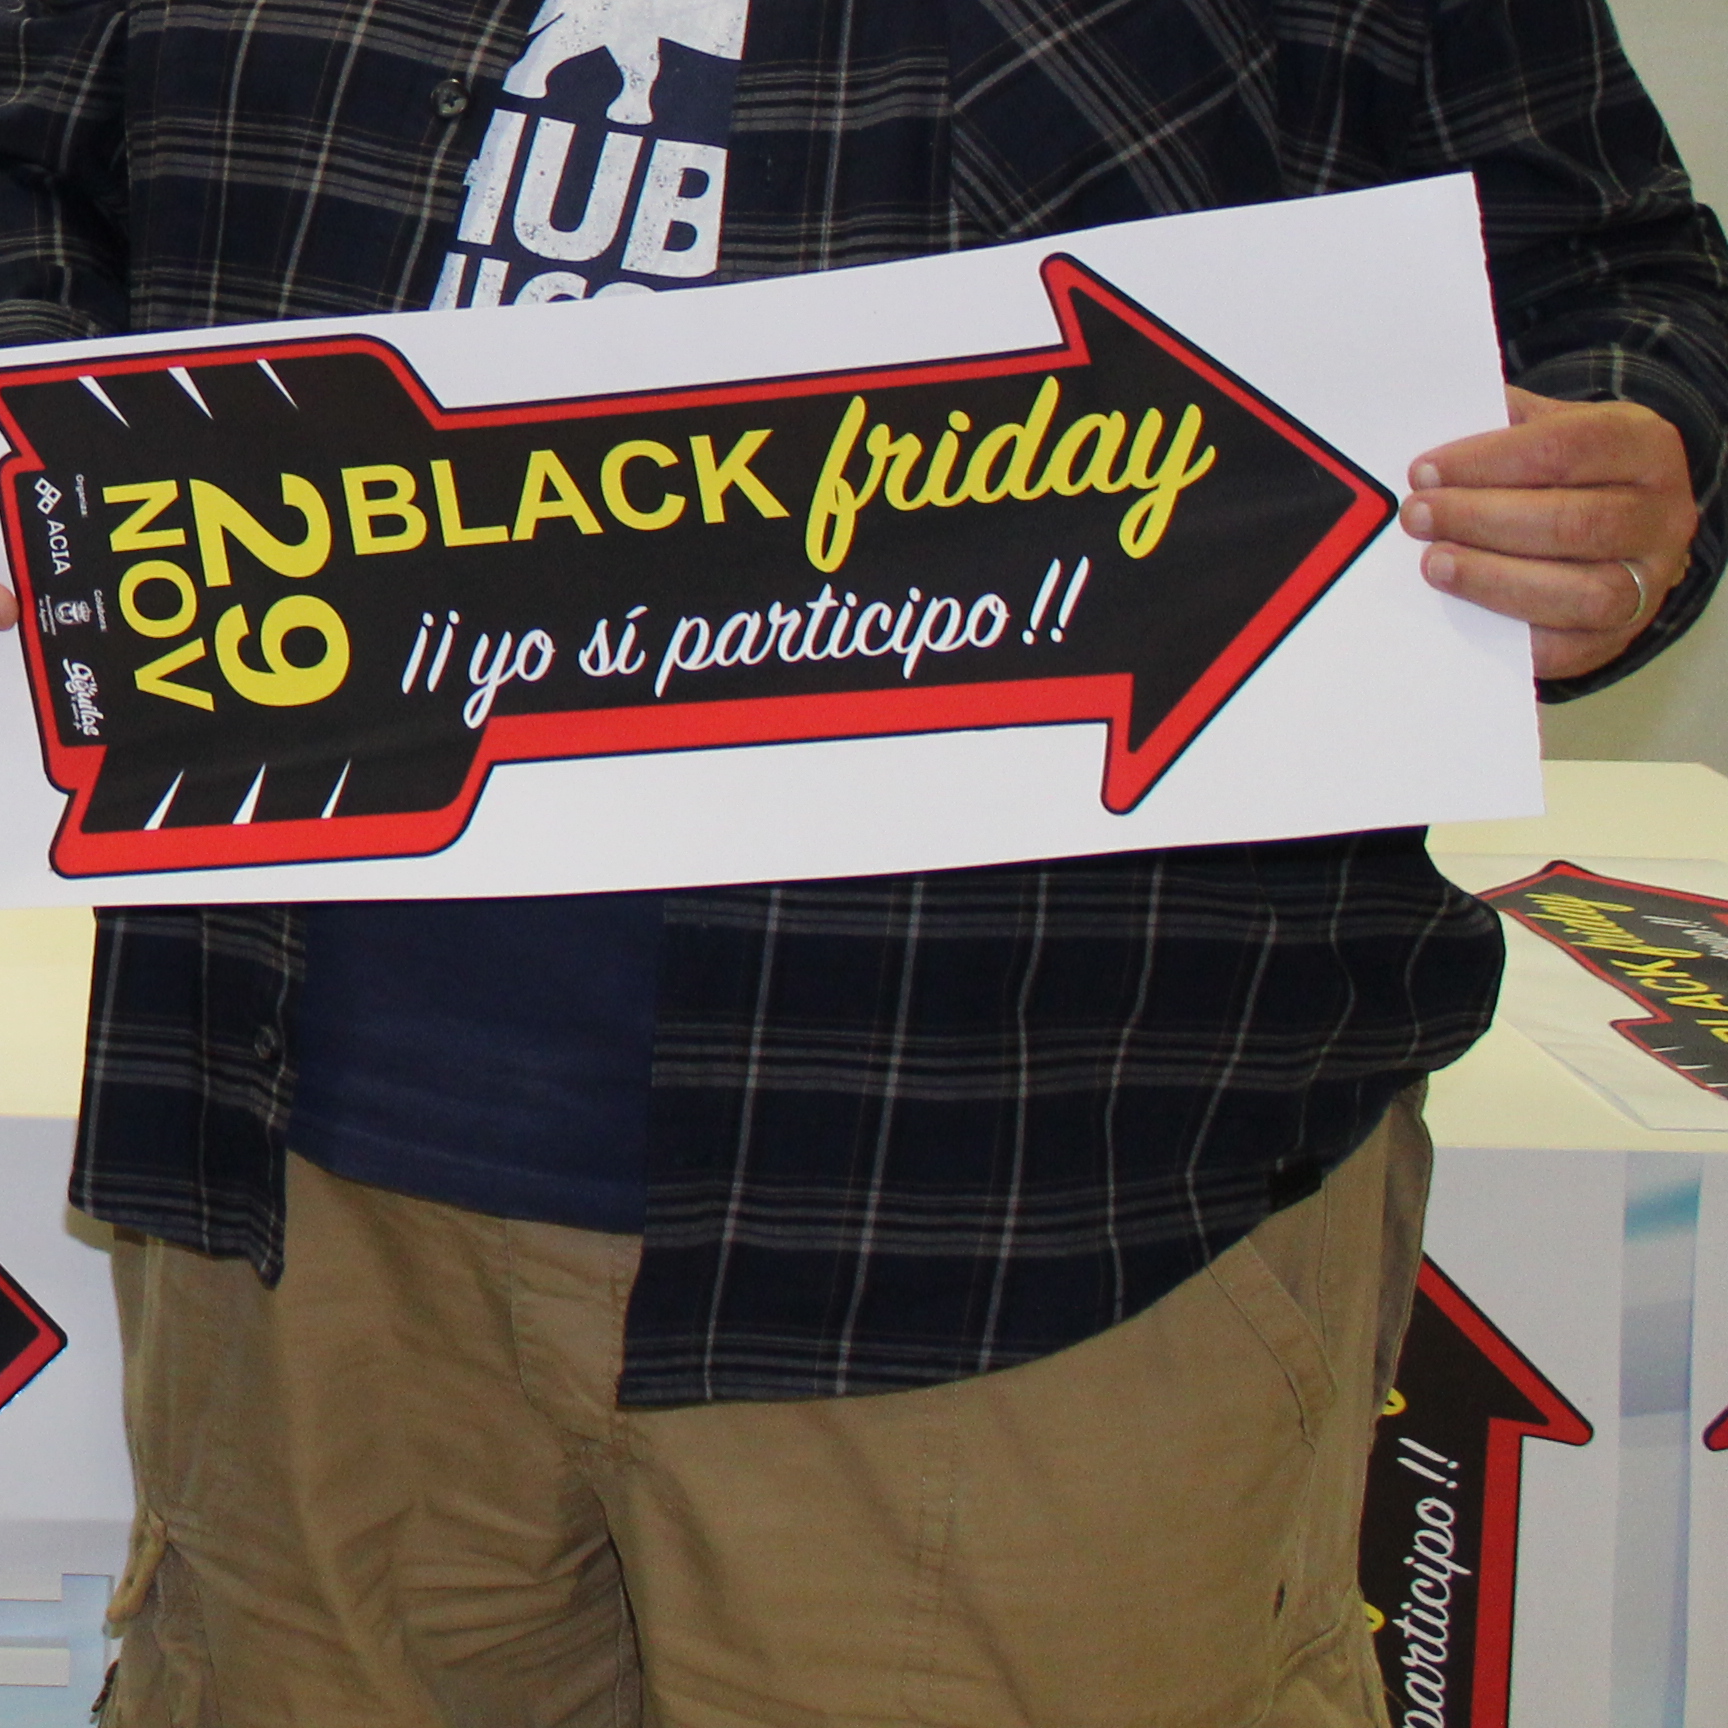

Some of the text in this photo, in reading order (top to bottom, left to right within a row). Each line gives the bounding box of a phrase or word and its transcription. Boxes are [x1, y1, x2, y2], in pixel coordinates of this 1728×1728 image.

[46, 518, 72, 575] ACIA
[341, 375, 1217, 574] BLACK friday
[102, 479, 215, 712] NOV
[189, 472, 351, 707] 29
[578, 605, 648, 677] sí
